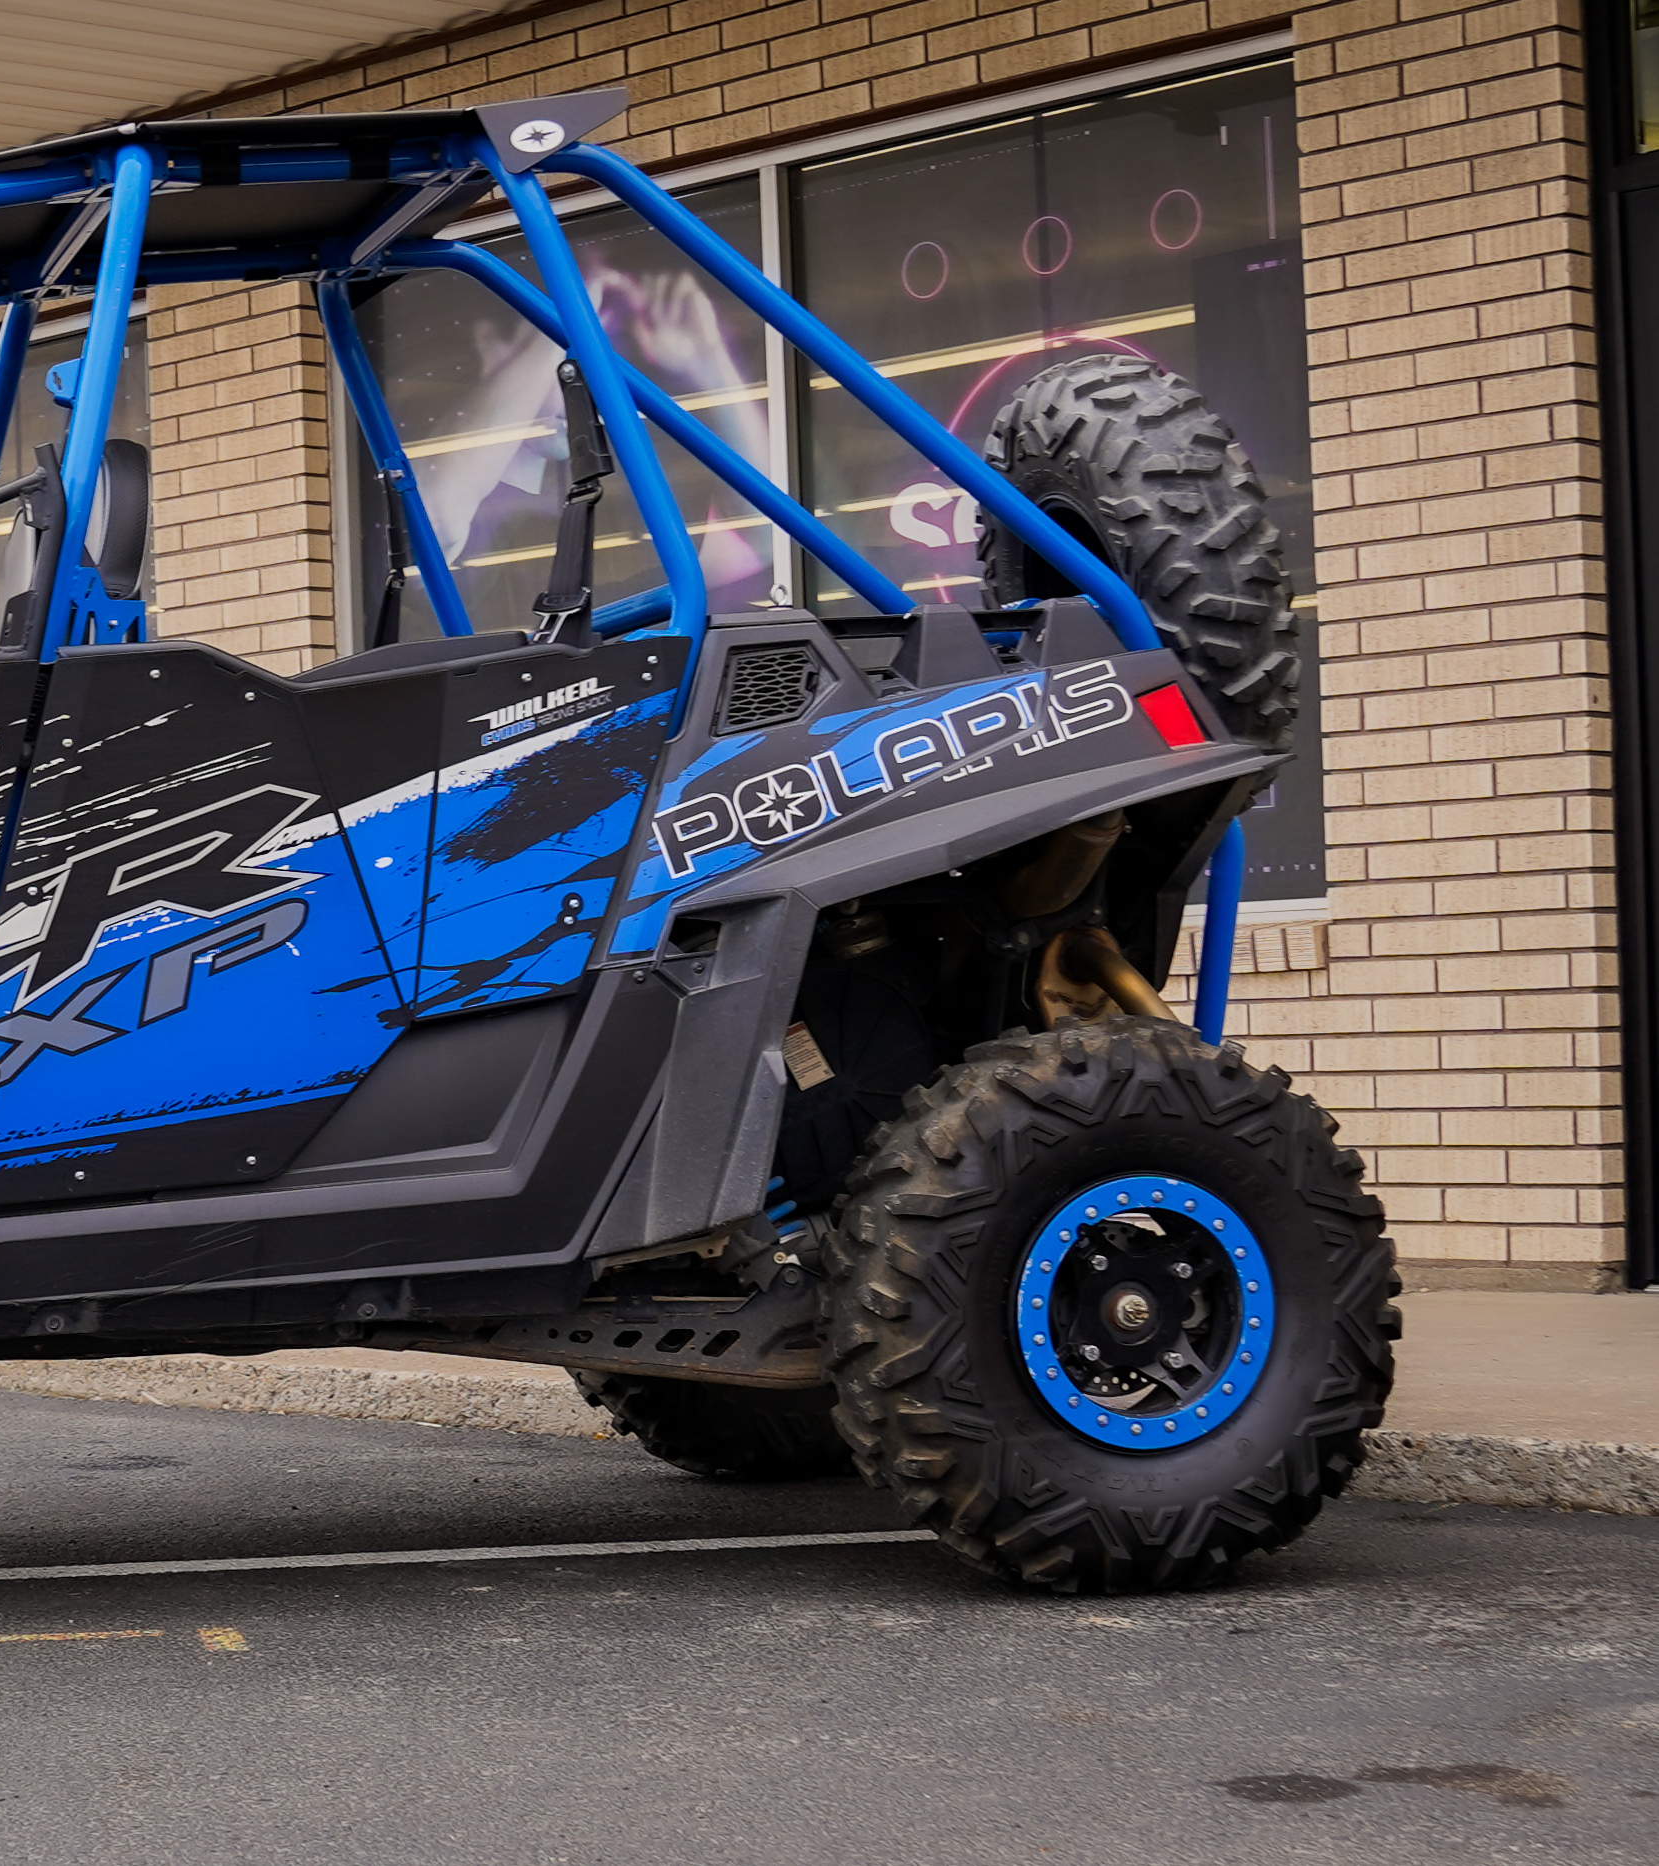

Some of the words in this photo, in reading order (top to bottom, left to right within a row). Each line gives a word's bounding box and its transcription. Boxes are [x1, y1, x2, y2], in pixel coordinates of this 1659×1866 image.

[467, 677, 616, 729] WALKER
[537, 703, 575, 727] RACING
[576, 692, 612, 715] SHOCK
[652, 660, 1134, 879] POLARIS
